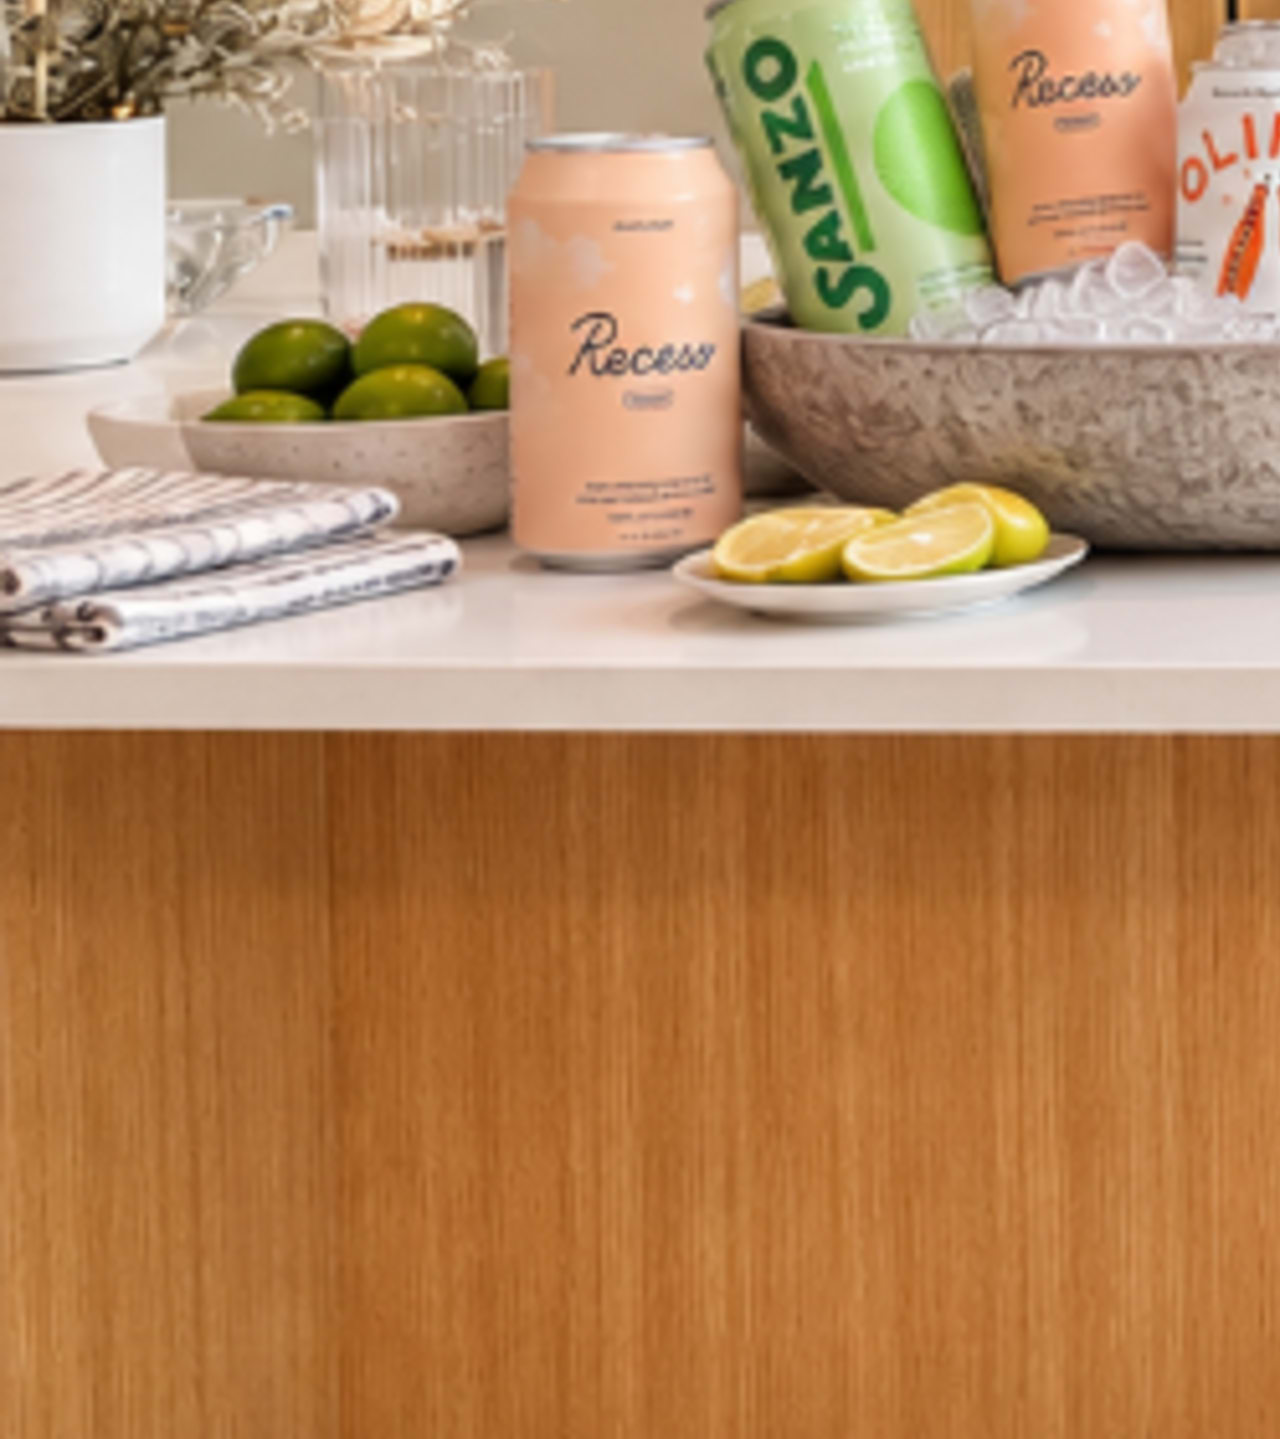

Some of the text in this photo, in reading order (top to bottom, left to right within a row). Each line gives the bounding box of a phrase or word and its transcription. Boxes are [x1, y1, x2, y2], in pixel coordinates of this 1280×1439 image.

[1008, 48, 1142, 110] Recess
[741, 34, 893, 331] SANZO
[567, 310, 717, 377] Recess
